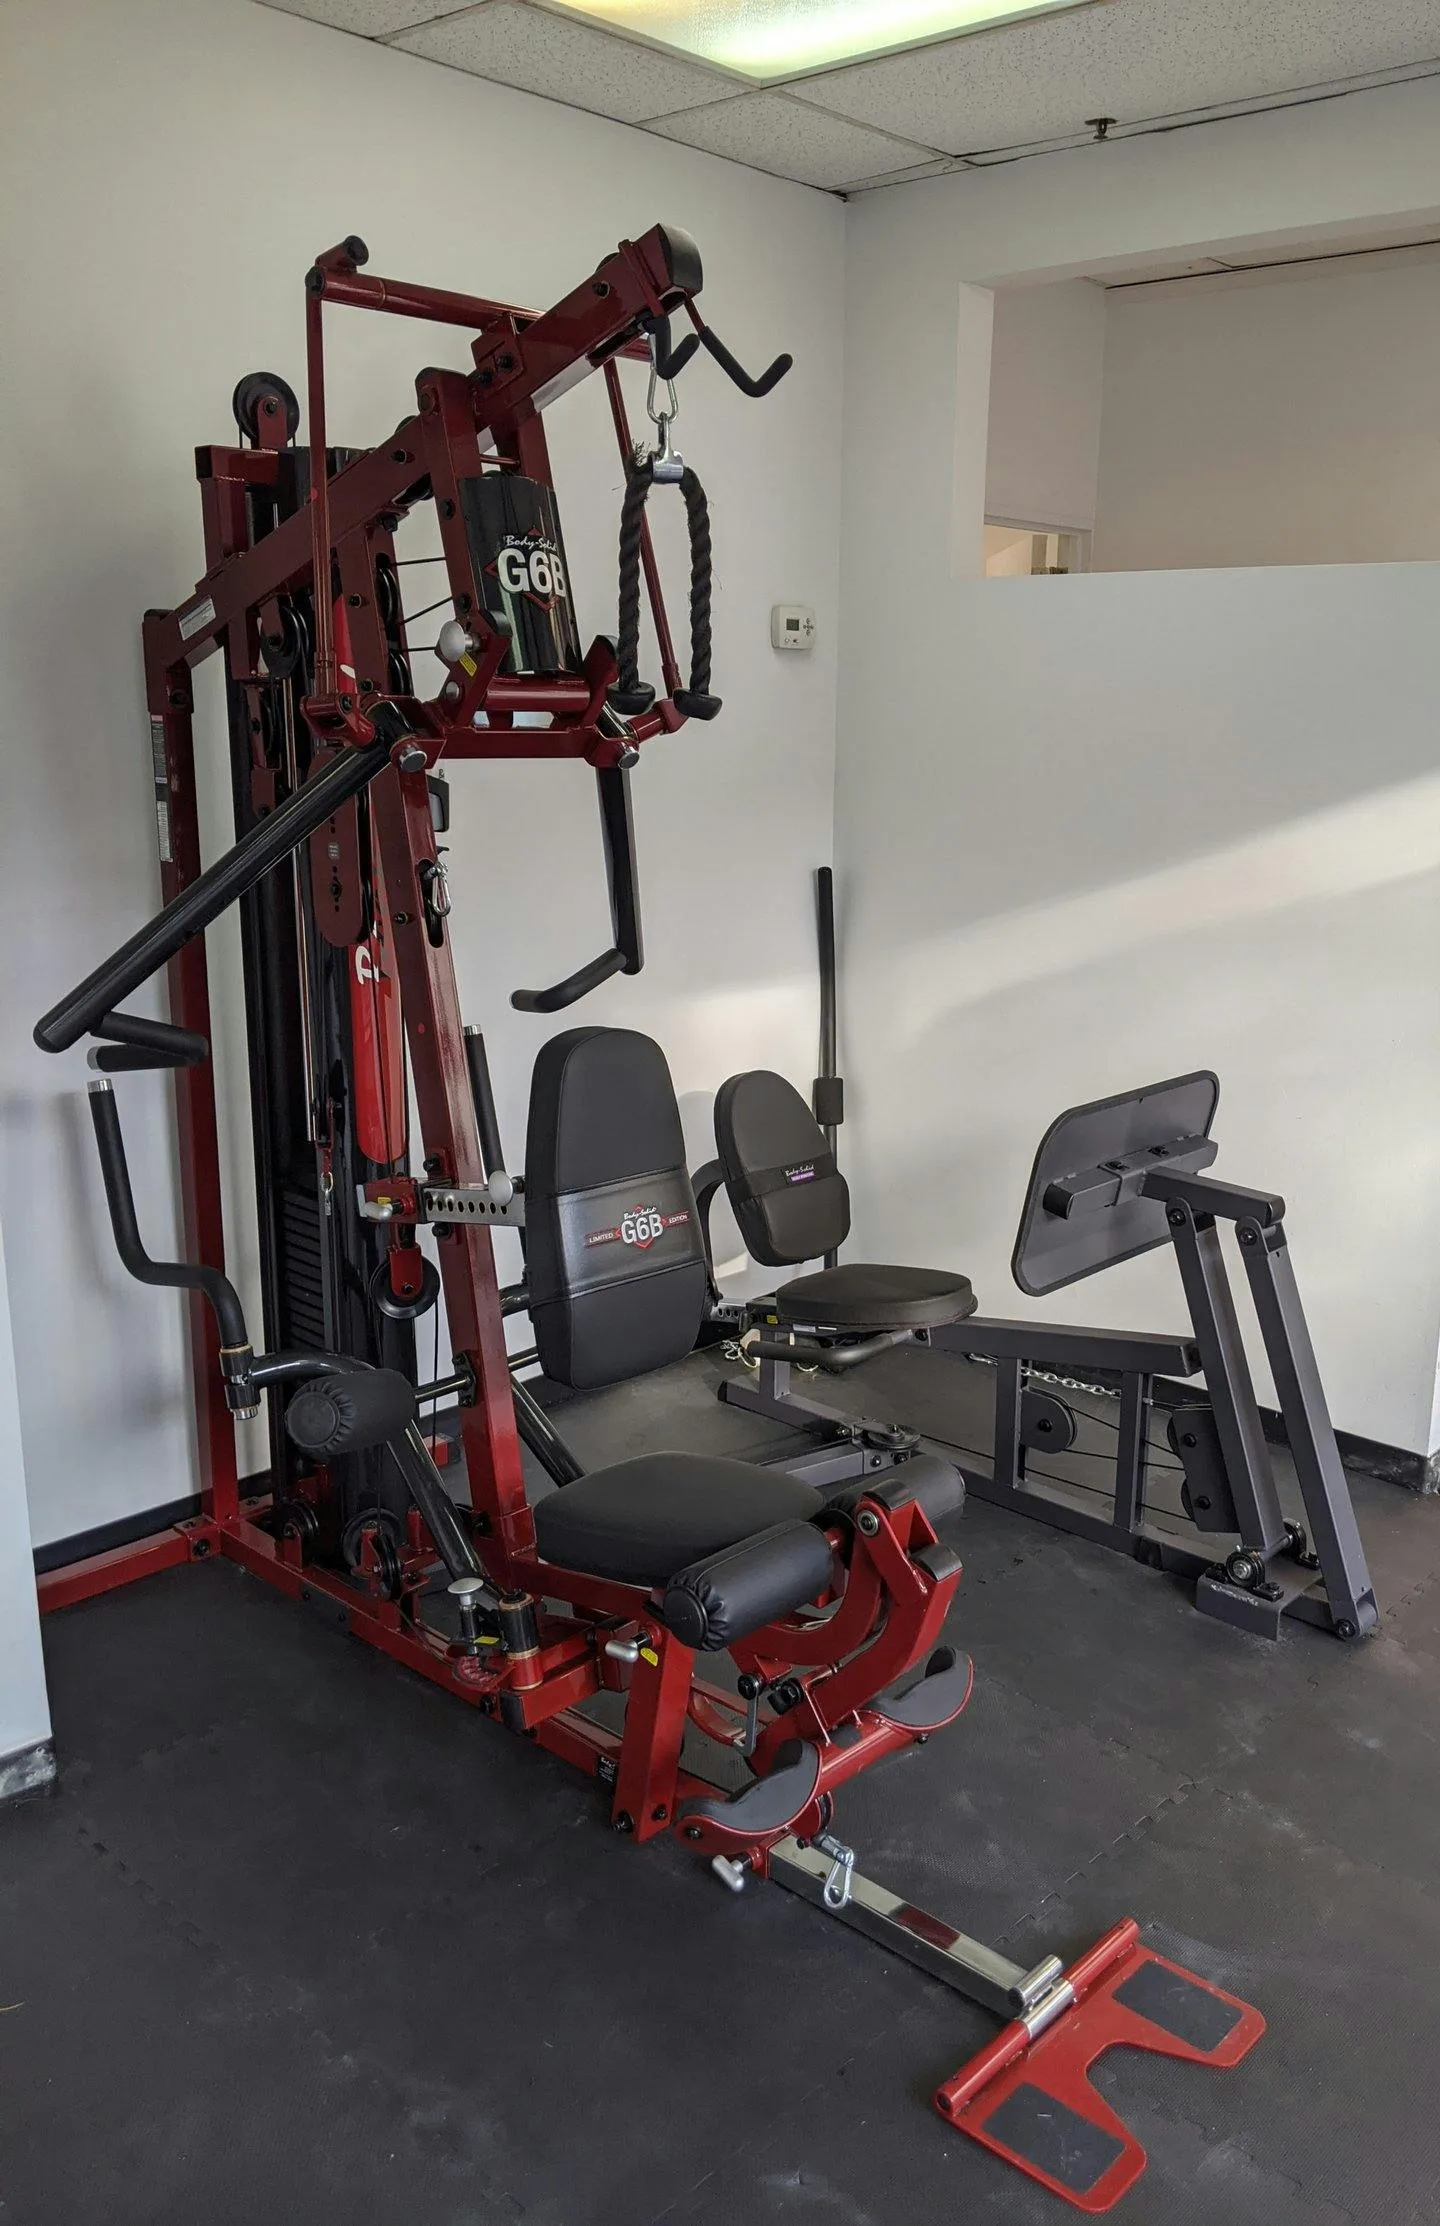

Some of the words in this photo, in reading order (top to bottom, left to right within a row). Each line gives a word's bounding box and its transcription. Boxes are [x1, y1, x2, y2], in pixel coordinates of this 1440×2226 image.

[505, 535, 557, 551] Body-Solid
[497, 548, 566, 597] G6B
[623, 1206, 657, 1220] Body-Solid
[589, 1232, 614, 1243] LIMITED
[621, 1213, 663, 1244] G6B
[669, 1214, 688, 1224] EDITION
